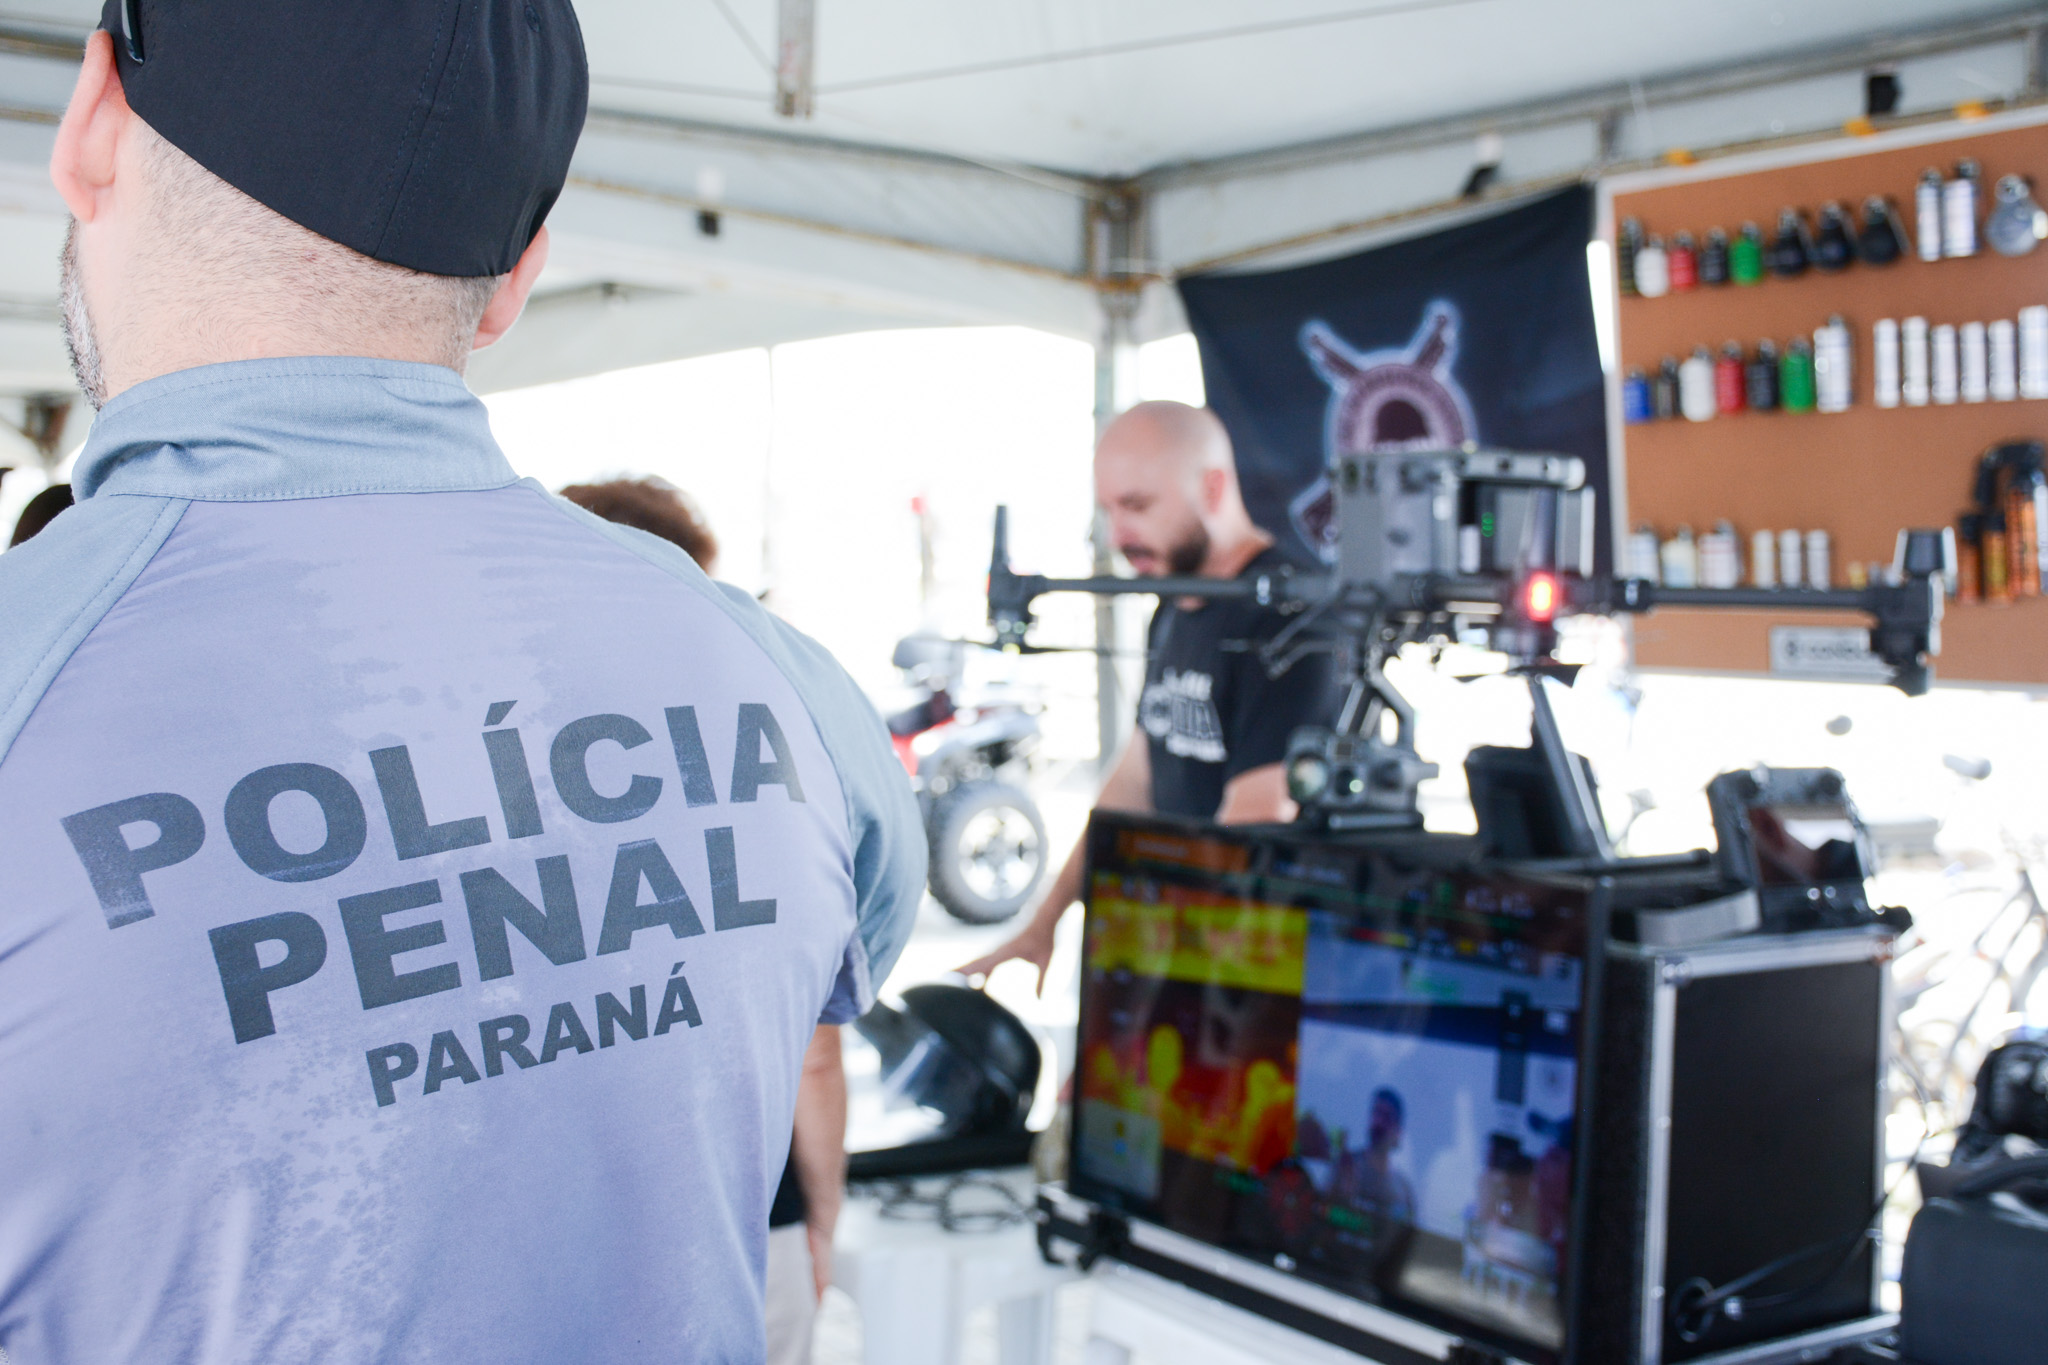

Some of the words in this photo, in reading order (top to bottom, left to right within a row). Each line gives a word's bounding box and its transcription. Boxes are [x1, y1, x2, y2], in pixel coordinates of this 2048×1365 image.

[61, 700, 806, 930] POLÍCIA
[208, 826, 777, 1045] PENAL
[365, 962, 703, 1108] PARANÁ
